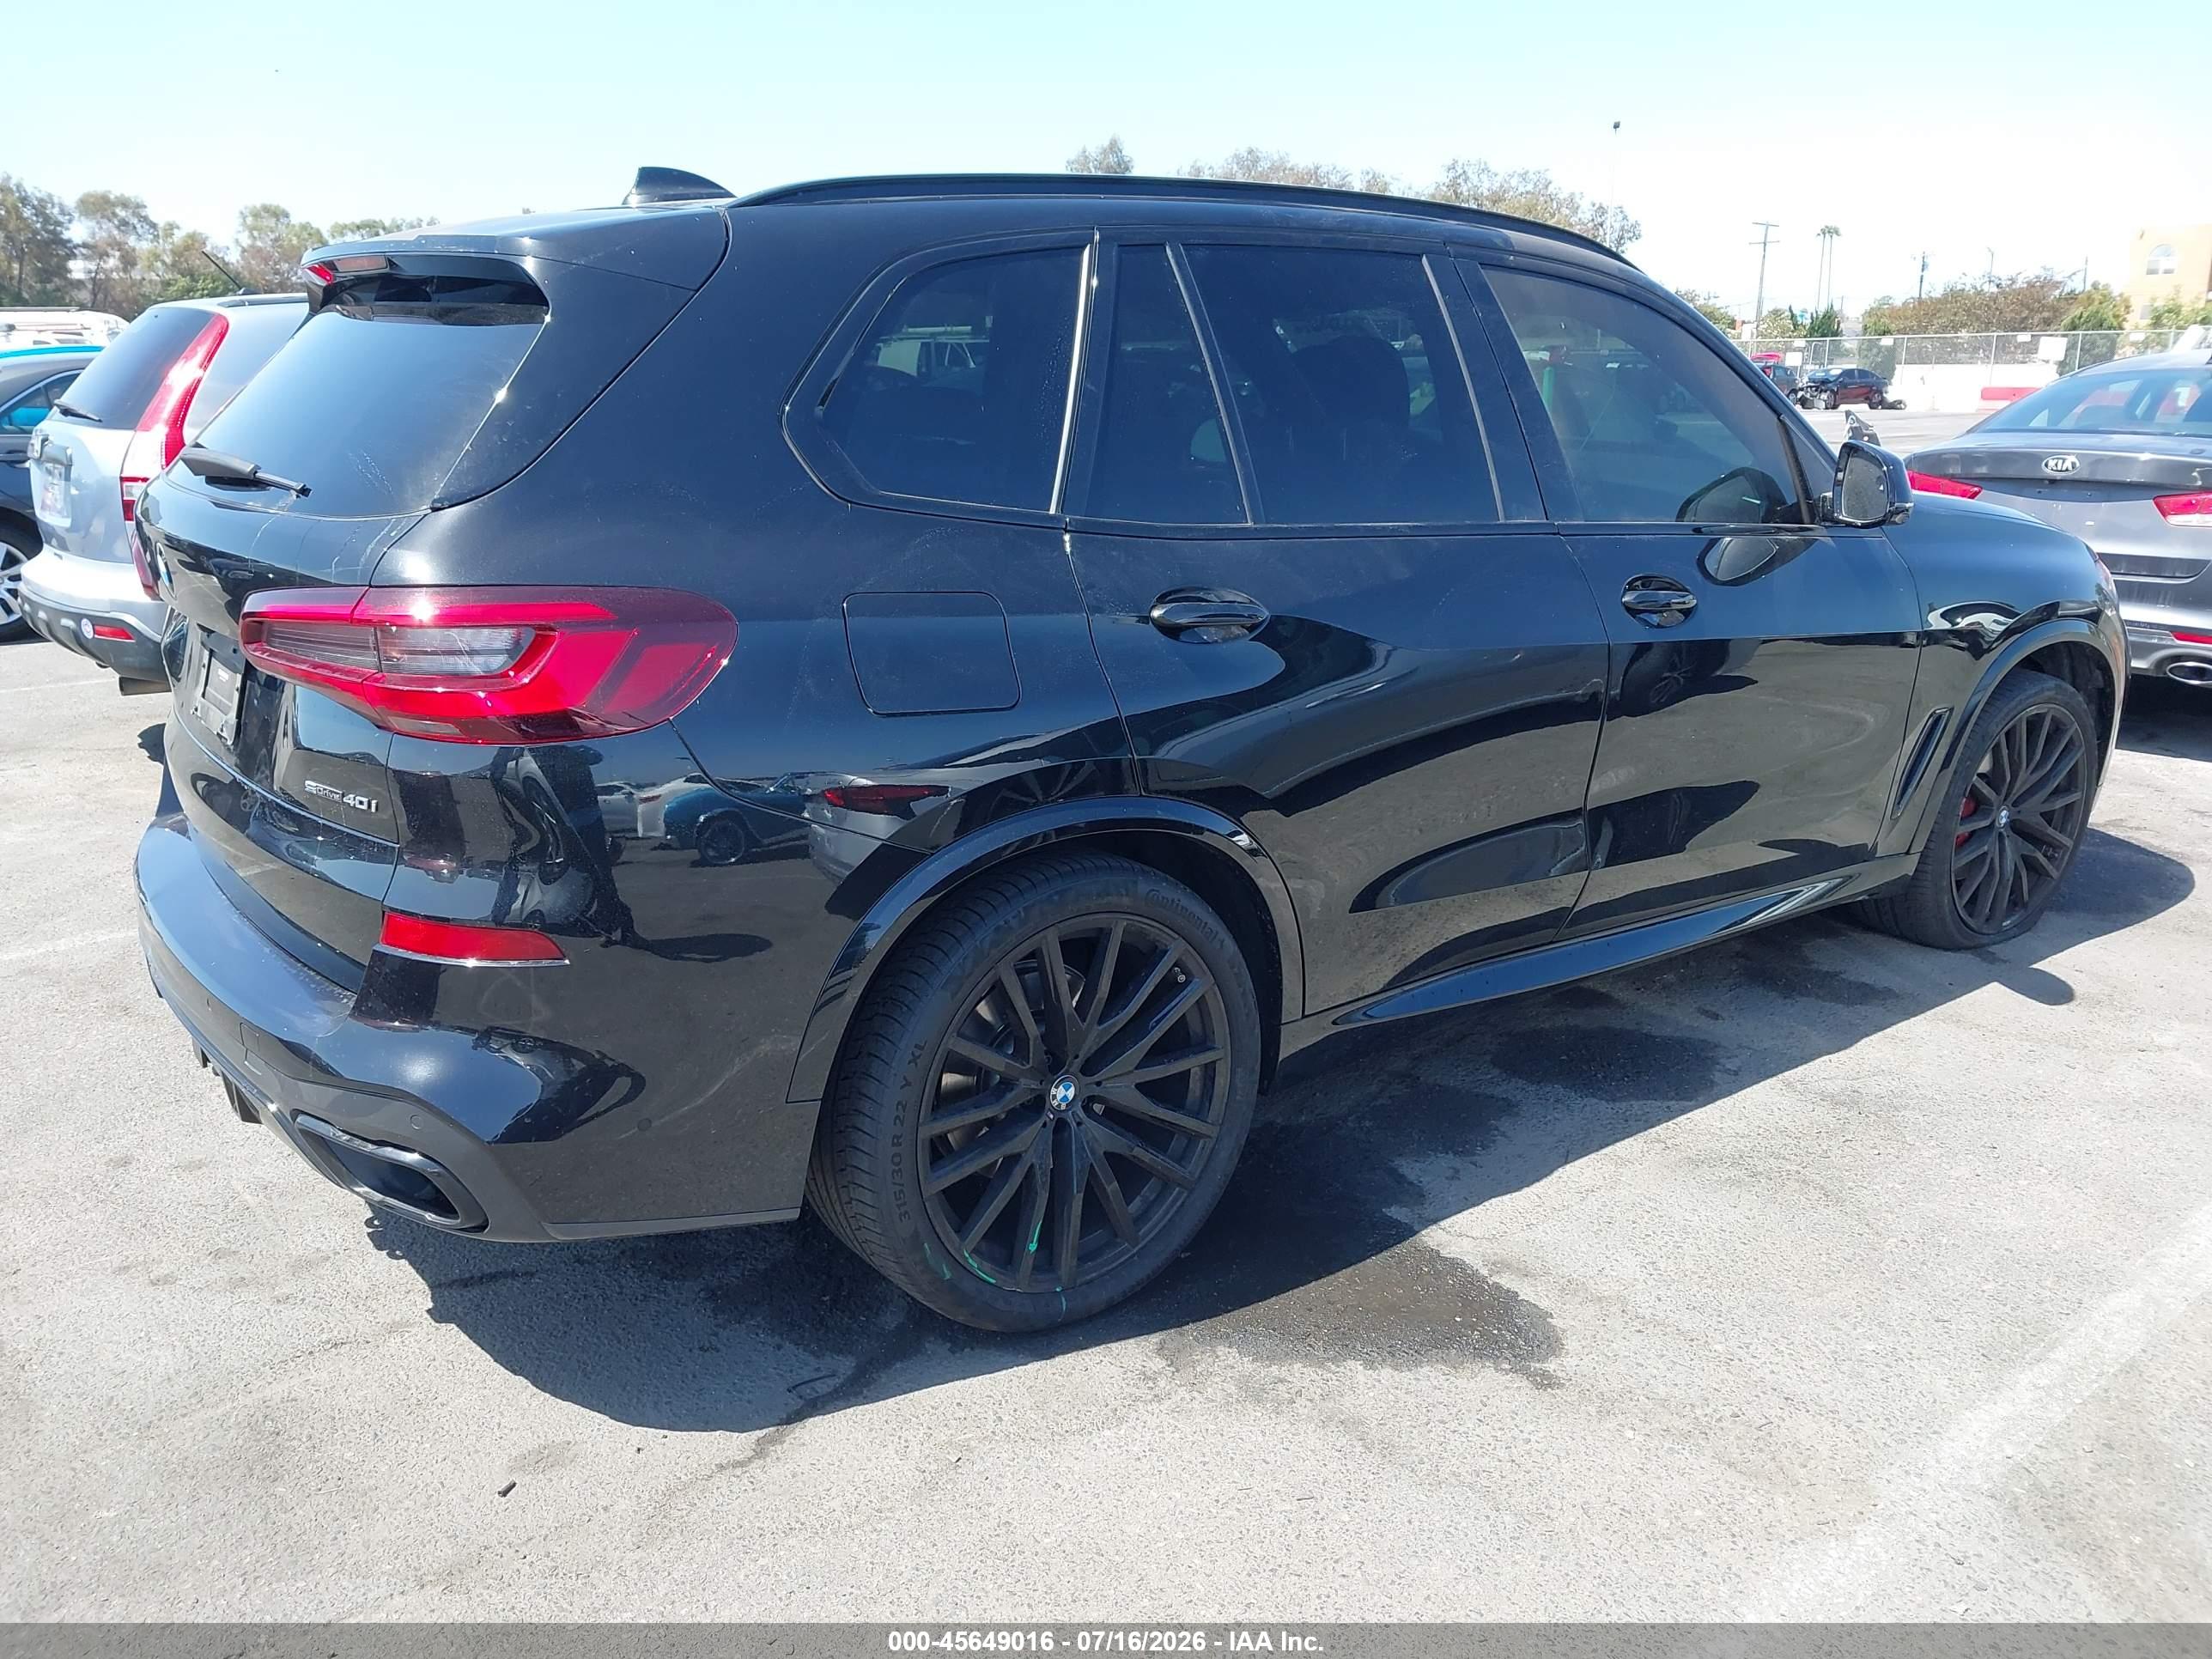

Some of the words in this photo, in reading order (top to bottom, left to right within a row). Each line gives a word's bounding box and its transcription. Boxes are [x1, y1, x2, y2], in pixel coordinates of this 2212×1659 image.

[2047, 459, 2074, 471] KIA
[1146, 888, 1219, 943] Continental
[908, 1039, 927, 1068] XL
[900, 1075, 913, 1090] Y
[891, 1153, 910, 1223] 315/30
